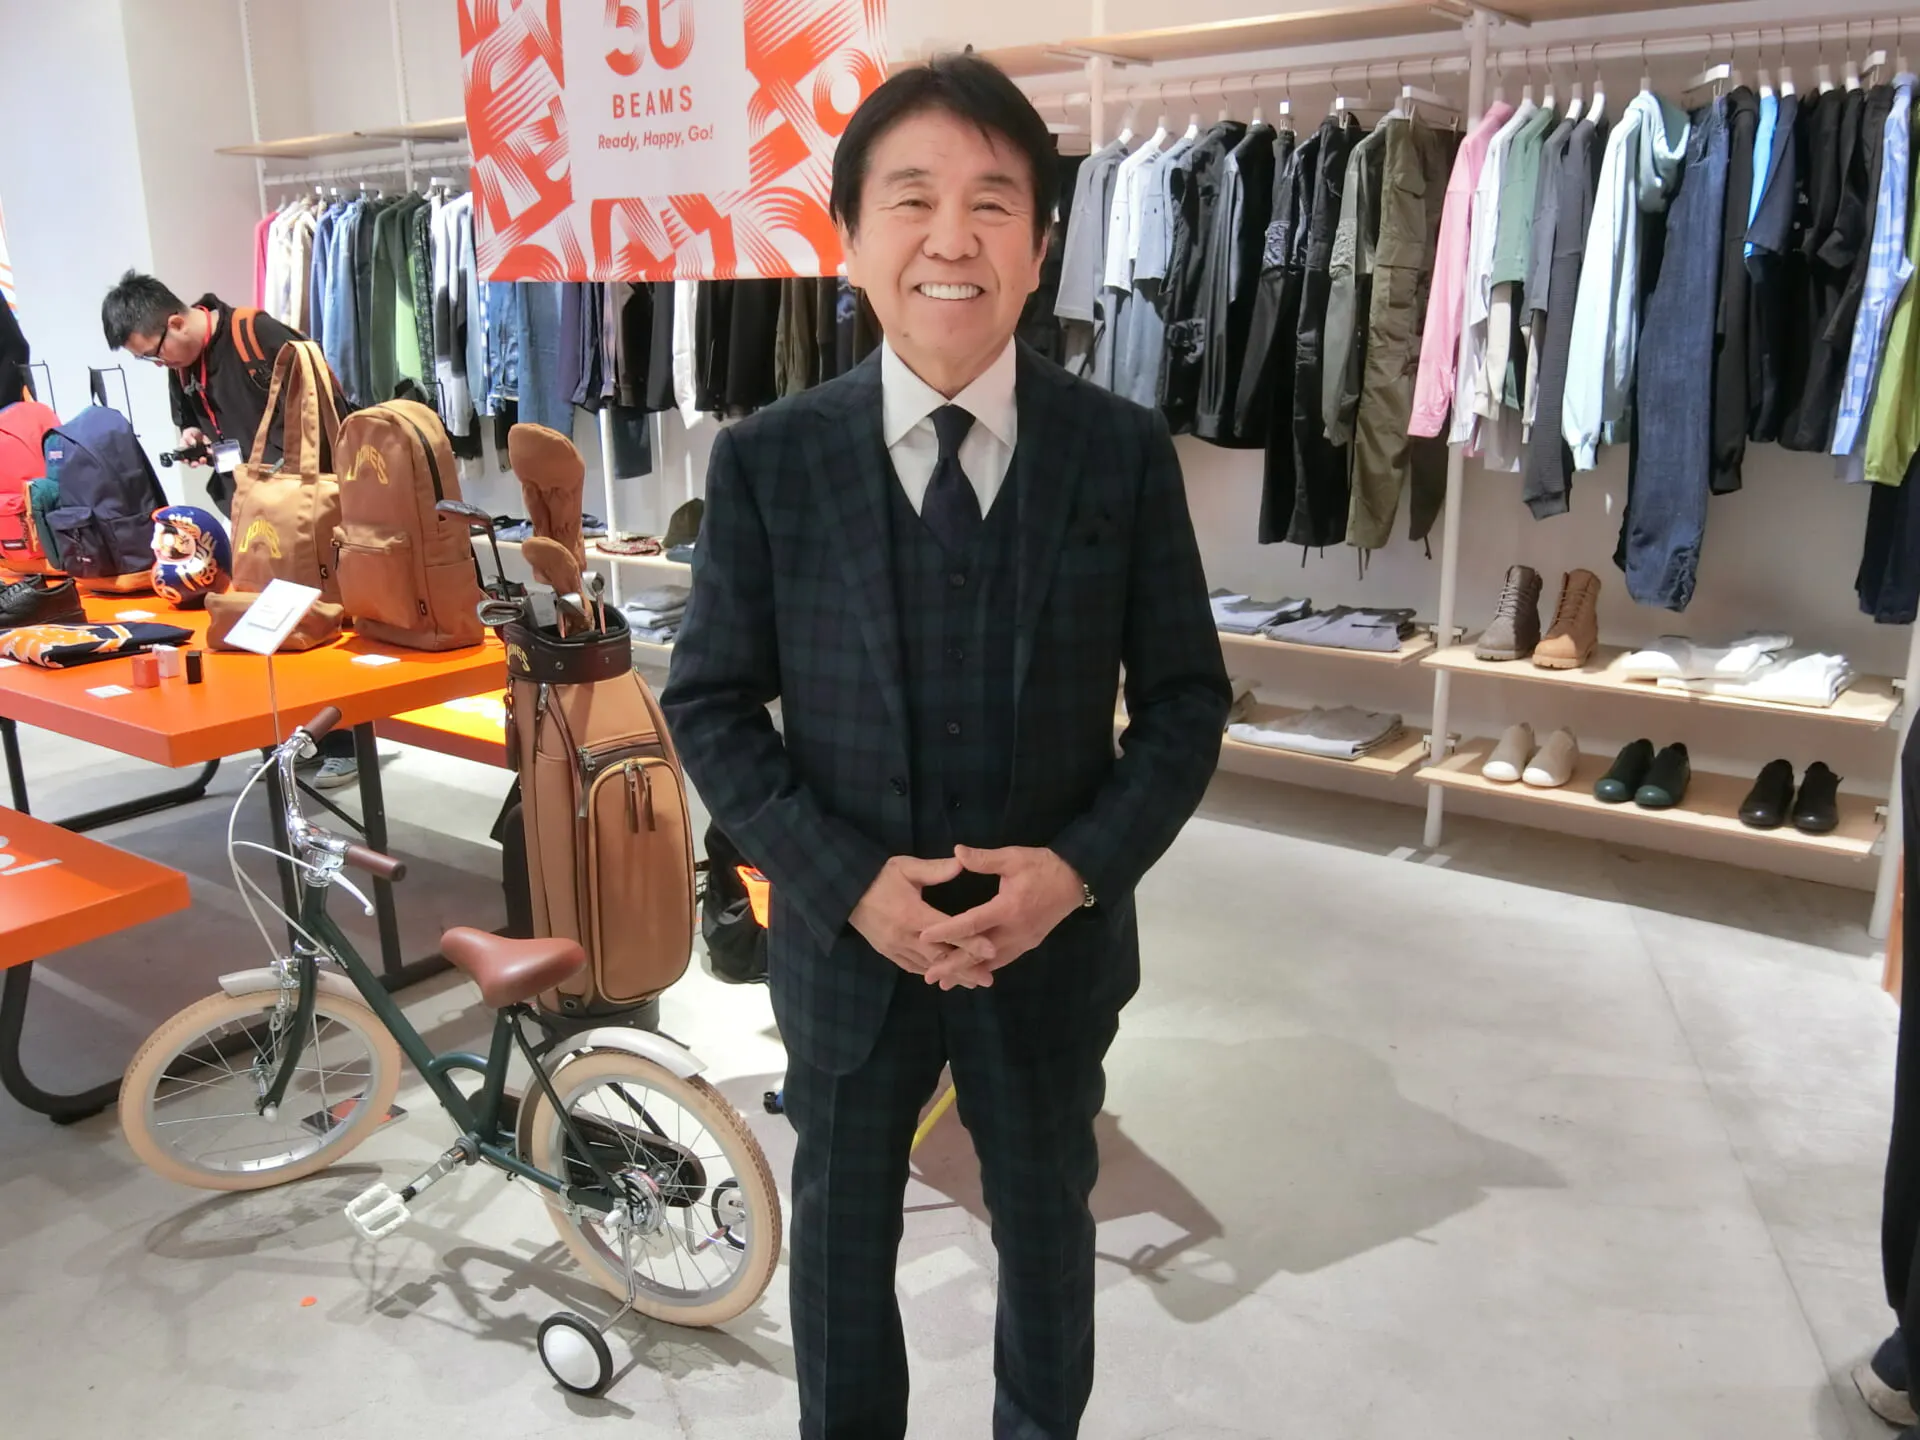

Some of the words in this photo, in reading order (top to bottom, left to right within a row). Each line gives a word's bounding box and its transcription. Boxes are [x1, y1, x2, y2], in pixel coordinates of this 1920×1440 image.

[612, 84, 693, 119] BEAMS
[598, 130, 639, 152] Ready,
[643, 130, 685, 150] Happy,
[688, 124, 714, 142] Go!
